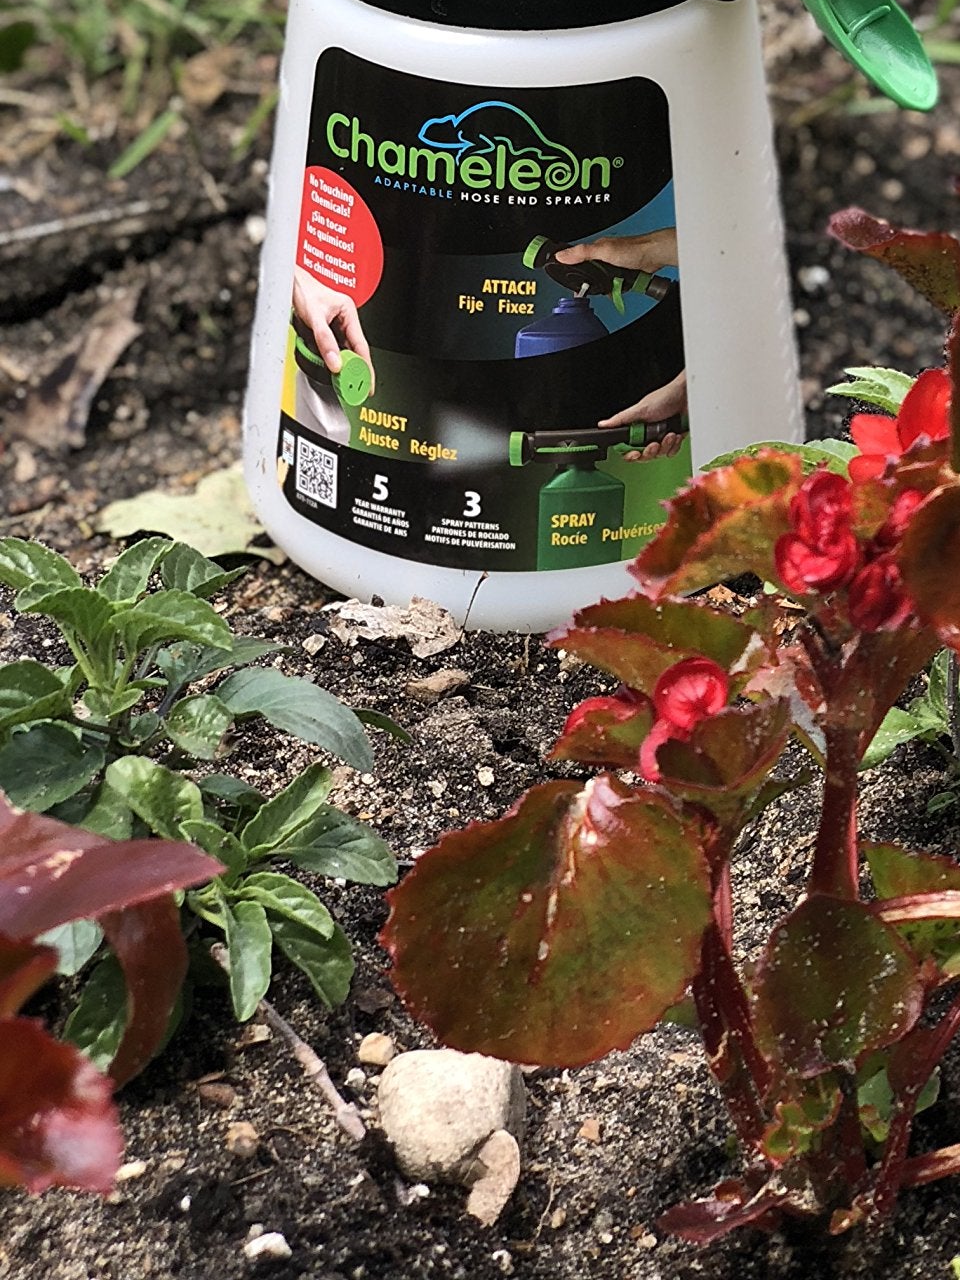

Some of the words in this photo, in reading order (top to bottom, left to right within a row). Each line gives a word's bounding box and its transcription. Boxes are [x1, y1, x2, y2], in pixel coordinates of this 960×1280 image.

[309, 173, 319, 187] No
[320, 178, 354, 207] Touching
[374, 175, 454, 200] ADAPTABLE
[460, 191, 500, 205] HOSE
[508, 195, 538, 206] END
[545, 193, 611, 206] SPRAYER
[311, 190, 351, 218] Chemicals!
[306, 221, 316, 236] los
[326, 217, 347, 235] tocar
[303, 239, 324, 260] Aucun
[325, 253, 356, 273] contact
[303, 253, 314, 269] les
[313, 261, 356, 288] chimiques!
[482, 279, 537, 295] ATTACH
[458, 295, 484, 314] Fije
[498, 299, 535, 315] Fixez
[359, 407, 407, 432] ADJUST
[359, 427, 400, 450] Ajuste
[410, 438, 458, 461] Réglez
[372, 474, 389, 501] 5
[354, 498, 370, 509] YEAR
[370, 502, 406, 518] WARRANTY
[463, 491, 481, 517] 3
[353, 516, 382, 531] GARANTIE
[384, 524, 392, 534] DE
[394, 526, 408, 538] ANS
[382, 514, 391, 524] DE
[441, 518, 464, 528] SPRAY
[464, 521, 500, 531] PATTERNS
[551, 512, 596, 528] SPRAY
[424, 534, 450, 545] MOTIFS
[451, 537, 460, 546] DE
[461, 538, 516, 550] PULVÉRISATION
[431, 526, 467, 537] PATRONES
[467, 530, 477, 539] DE
[478, 532, 509, 540] ROCIADO
[551, 531, 588, 546] Rocíe
